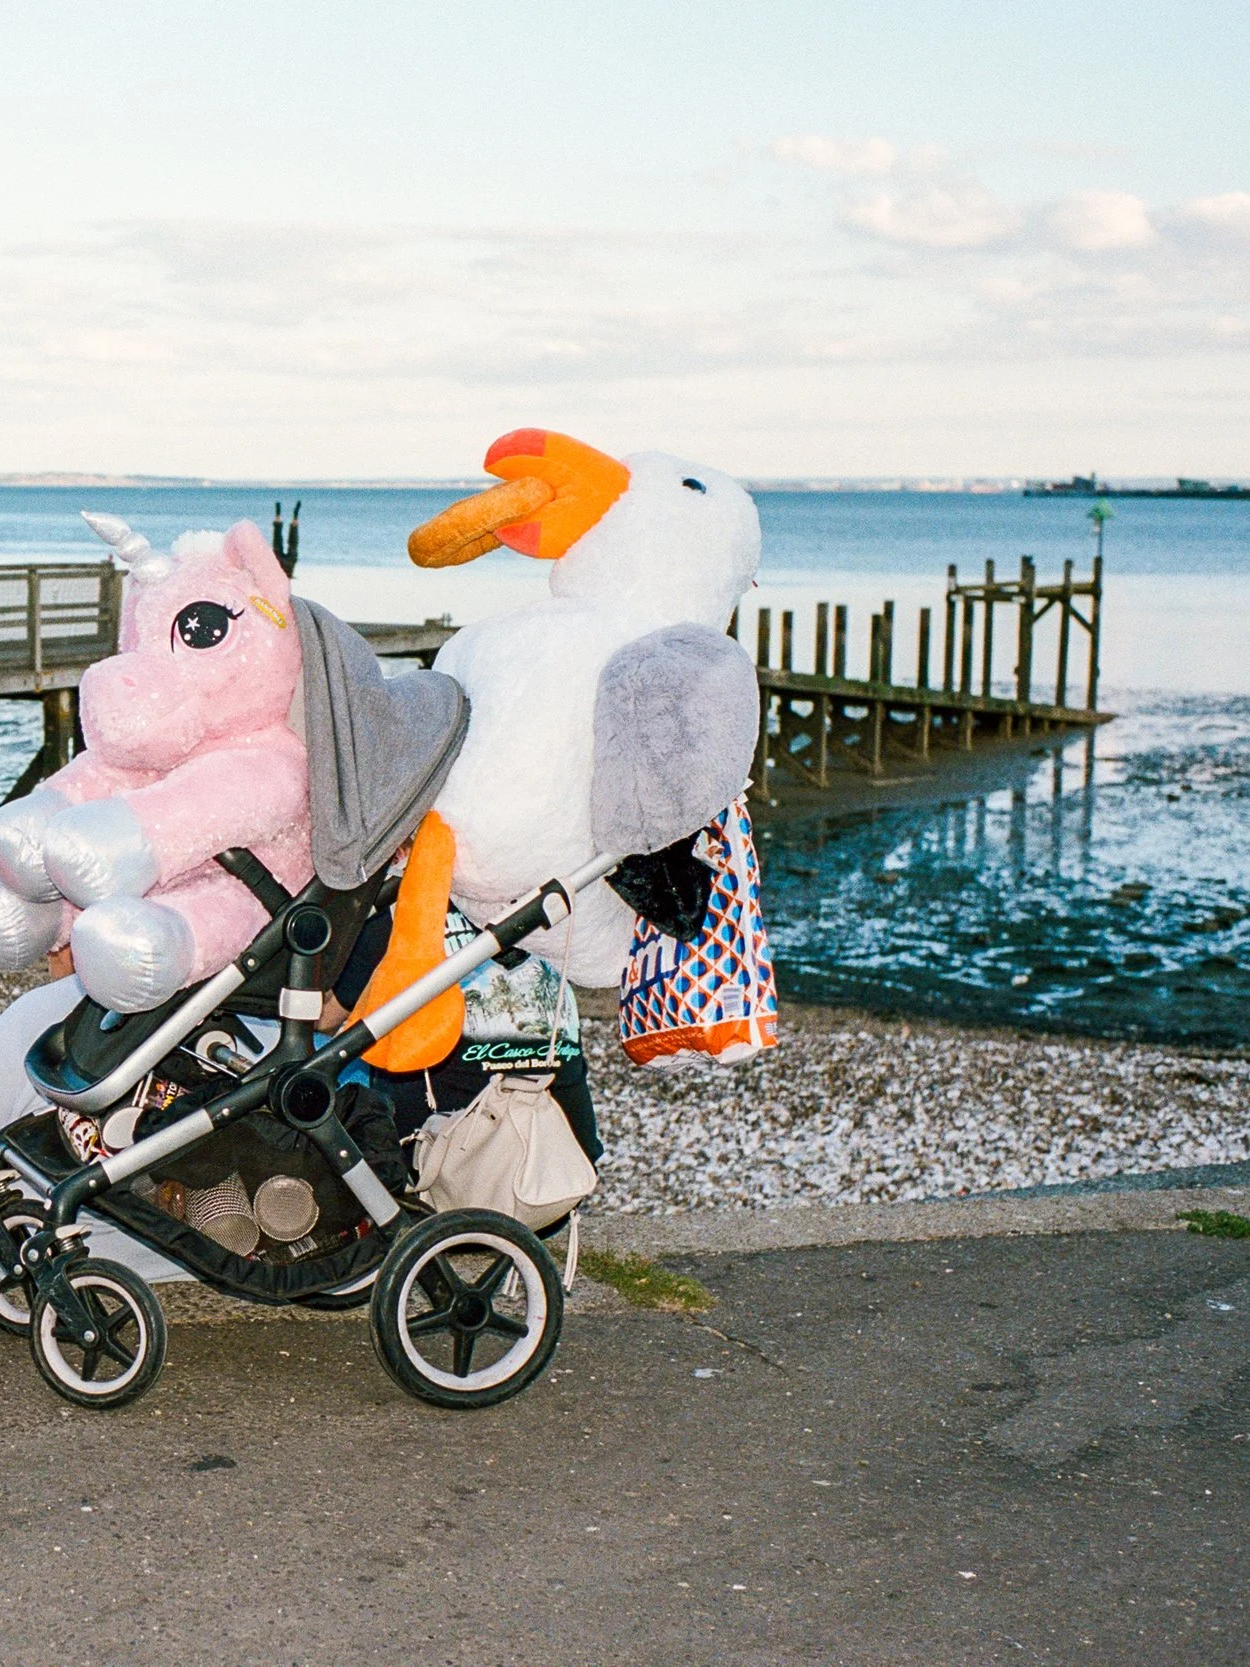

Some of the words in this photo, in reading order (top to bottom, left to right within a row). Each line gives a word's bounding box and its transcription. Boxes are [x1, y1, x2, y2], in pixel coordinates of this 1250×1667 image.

[462, 1043, 491, 1061] El
[488, 1042, 535, 1059] Casco
[514, 1059, 530, 1069] del
